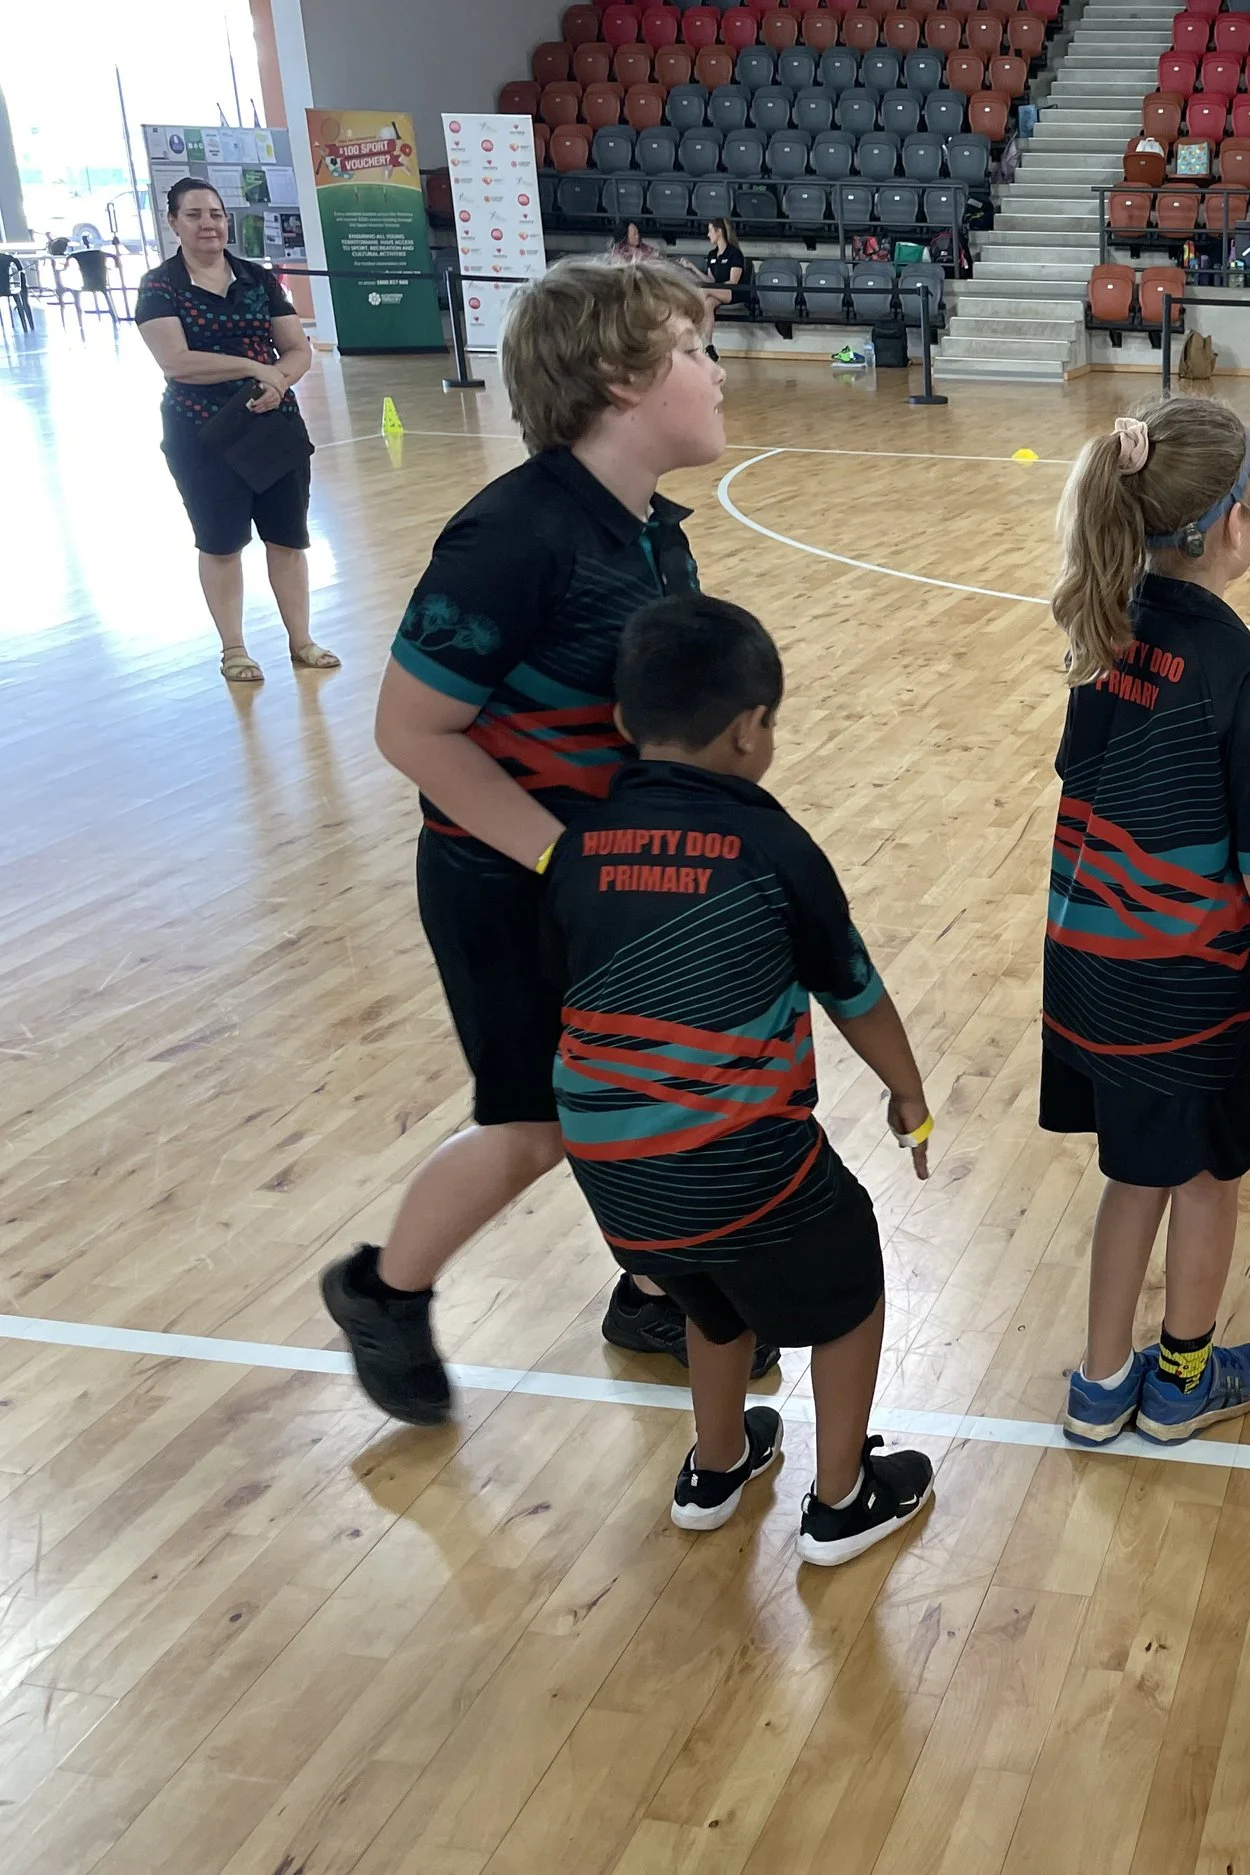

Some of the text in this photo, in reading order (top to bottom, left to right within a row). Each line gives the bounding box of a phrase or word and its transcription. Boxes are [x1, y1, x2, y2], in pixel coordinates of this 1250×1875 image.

[361, 141, 389, 153] SPORT
[345, 155, 391, 170] VOUCHER?
[1149, 647, 1185, 683] DOO
[582, 829, 742, 860] HUMPTY DOO
[599, 865, 713, 894] PRIMARY
